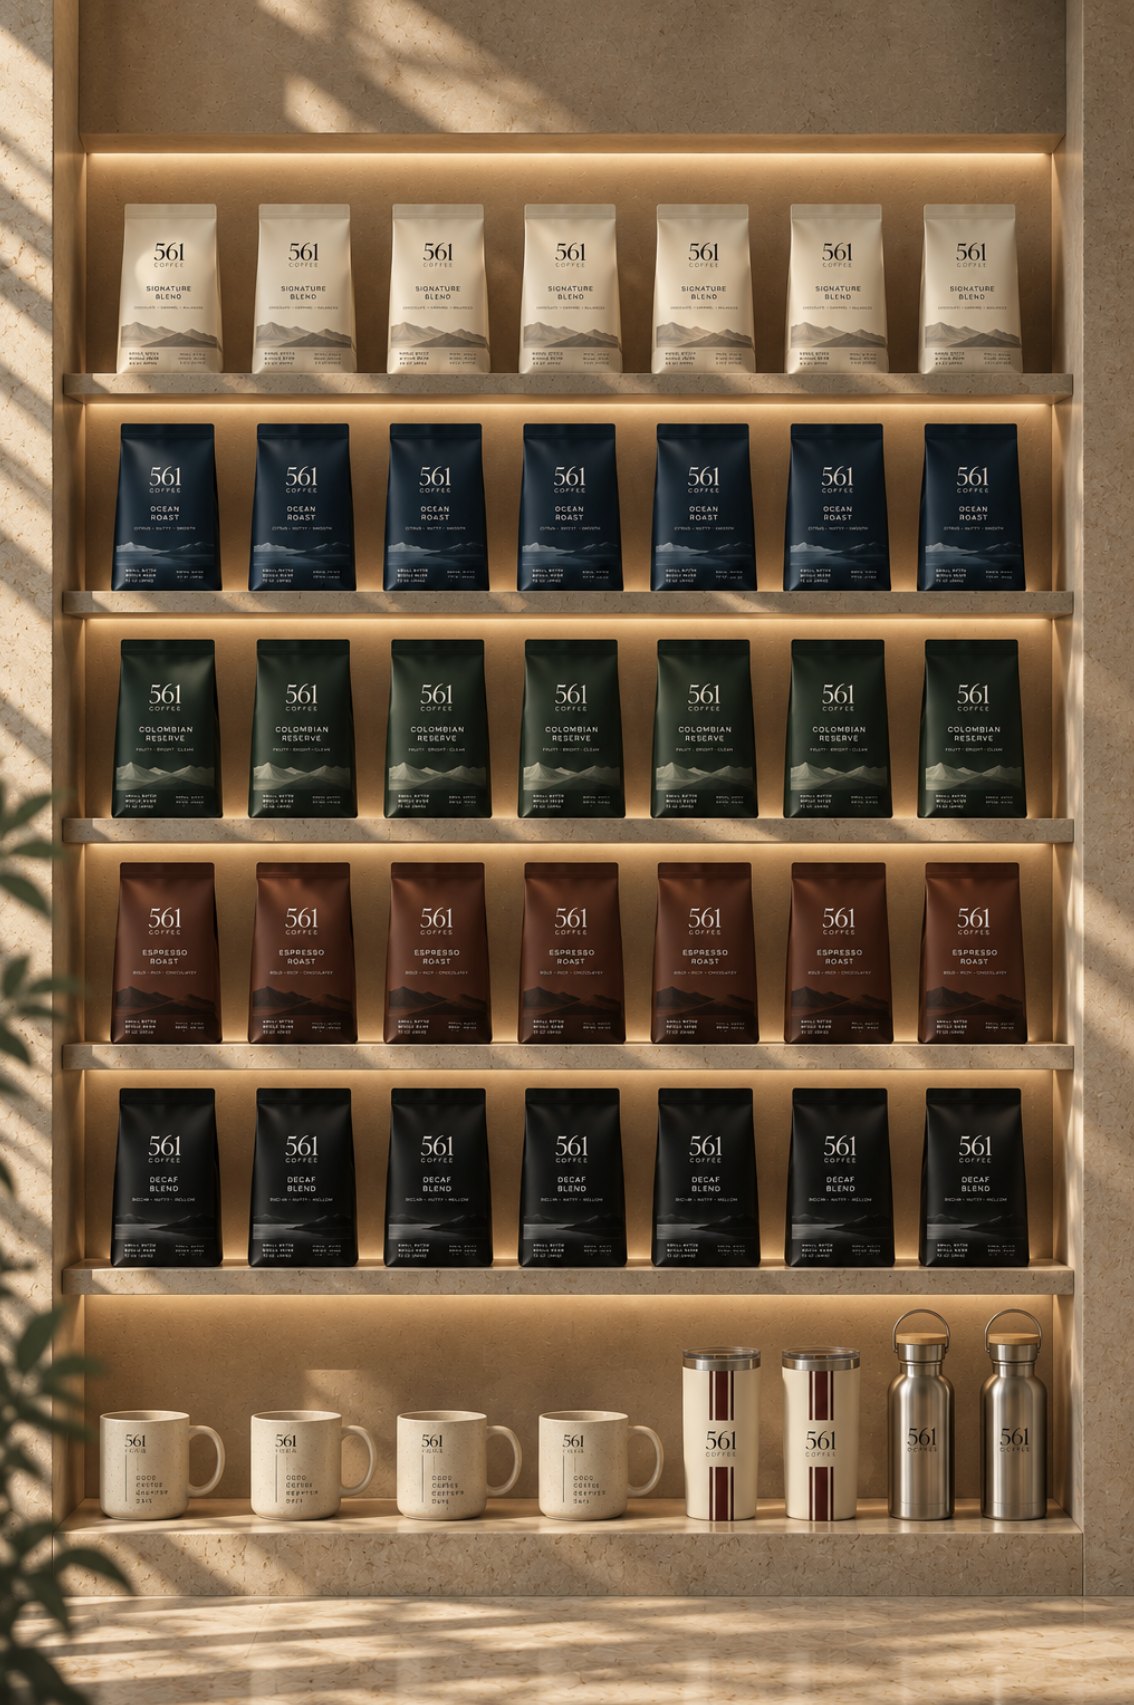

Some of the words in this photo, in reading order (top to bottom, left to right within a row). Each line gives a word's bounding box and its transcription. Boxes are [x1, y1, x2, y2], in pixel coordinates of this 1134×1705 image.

[153, 242, 184, 262] 561
[288, 242, 319, 262] 561
[422, 242, 453, 262] 561
[554, 242, 586, 262] 561
[688, 242, 719, 262] 561
[821, 242, 852, 262] 561
[956, 242, 986, 262] 561
[145, 285, 192, 293] SIGNATURE
[280, 285, 326, 293] SIGNATURE
[415, 285, 461, 293] SIGNATURE
[547, 285, 593, 293] SIGNATURE
[680, 285, 727, 293] SIGNATURE
[814, 285, 862, 293] SIGNATURE
[949, 285, 995, 293] SIGNATURE
[155, 293, 182, 301] BLEND
[289, 293, 317, 301] BLEND
[424, 293, 452, 301] BLEND
[557, 293, 585, 301] BLEND
[690, 293, 718, 301] BLEND
[824, 293, 852, 301] BLEND
[958, 293, 986, 301] BLEND
[149, 466, 182, 487] 561
[285, 466, 318, 487] 561
[419, 466, 452, 487] 561
[553, 466, 586, 487] 561
[687, 466, 720, 487] 561
[821, 466, 854, 487] 561
[956, 466, 989, 487] 561
[149, 505, 180, 513] OCEAN
[286, 505, 316, 513] OCEAN
[420, 505, 450, 513] OCEAN
[554, 505, 584, 513] OCEAN
[688, 505, 719, 513] OCEAN
[822, 505, 853, 513] OCEAN
[958, 505, 988, 513] OCEAN
[150, 513, 180, 522] ROAST
[286, 513, 317, 522] ROAST
[420, 513, 451, 522] ROAST
[554, 513, 584, 522] ROAST
[689, 513, 719, 522] ROAST
[823, 513, 853, 522] ROAST
[959, 513, 988, 522] ROAST
[148, 683, 181, 705] 561
[285, 683, 318, 705] 561
[420, 683, 453, 705] 561
[554, 683, 587, 705] 561
[687, 683, 721, 705] 561
[822, 683, 854, 705] 561
[956, 683, 990, 705] 561
[138, 726, 194, 734] COLOMBIAN
[275, 726, 329, 734] COLOMBIAN
[410, 726, 465, 734] COLOMBIAN
[544, 726, 599, 734] COLOMBIAN
[678, 726, 732, 734] COLOMBIAN
[812, 726, 866, 734] COLOMBIAN
[947, 726, 1001, 734] COLOMBIAN
[145, 734, 185, 743] RESERVE
[281, 734, 322, 743] RESERVE
[417, 734, 457, 743] RESERVE
[551, 734, 591, 743] RESERVE
[684, 734, 724, 743] RESERVE
[819, 734, 859, 743] RESERVE
[954, 734, 994, 743] RESERVE
[148, 907, 181, 929] 561
[284, 907, 318, 929] 561
[420, 907, 453, 929] 561
[554, 907, 588, 929] 561
[688, 907, 721, 929] 561
[822, 907, 855, 929] 561
[957, 907, 990, 929] 561
[142, 949, 188, 957] ESPRESSO
[278, 949, 325, 957] ESPRESSO
[413, 949, 461, 957] ESPRESSO
[548, 949, 596, 957] ESPRESSO
[682, 949, 729, 957] ESPRESSO
[816, 949, 863, 957] ESPRESSO
[951, 949, 998, 957] ESPRESSO
[149, 958, 179, 966] ROAST
[287, 958, 316, 966] ROAST
[422, 958, 451, 966] ROAST
[556, 958, 586, 966] ROAST
[690, 958, 720, 966] ROAST
[824, 958, 854, 966] ROAST
[959, 958, 989, 966] ROAST
[148, 1135, 181, 1157] 561
[285, 1135, 319, 1157] 561
[420, 1135, 454, 1157] 561
[555, 1135, 588, 1157] 561
[688, 1135, 722, 1157] 561
[823, 1135, 857, 1157] 561
[958, 1135, 992, 1157] 561
[149, 1175, 179, 1184] DECAF
[286, 1175, 316, 1184] DECAF
[422, 1175, 452, 1184] DECAF
[557, 1175, 586, 1184] DECAF
[691, 1175, 721, 1184] DECAF
[826, 1175, 855, 1184] DECAF
[961, 1175, 990, 1184] DECAF
[149, 1184, 179, 1193] BLEND
[286, 1184, 317, 1193] BLEND
[422, 1184, 453, 1193] BLEND
[556, 1184, 587, 1193] BLEND
[691, 1184, 721, 1193] BLEND
[825, 1184, 856, 1193] BLEND
[960, 1184, 991, 1193] BLEND
[124, 1433, 147, 1448] 561
[274, 1433, 298, 1448] 561
[421, 1433, 443, 1448] 561
[562, 1433, 584, 1448] 561
[705, 1429, 737, 1451] 561
[805, 1429, 837, 1451] 561
[906, 1427, 937, 1447] 561
[1000, 1427, 1030, 1447] 561
[705, 1450, 737, 1458] COFFEE
[805, 1450, 837, 1458] COFFEE
